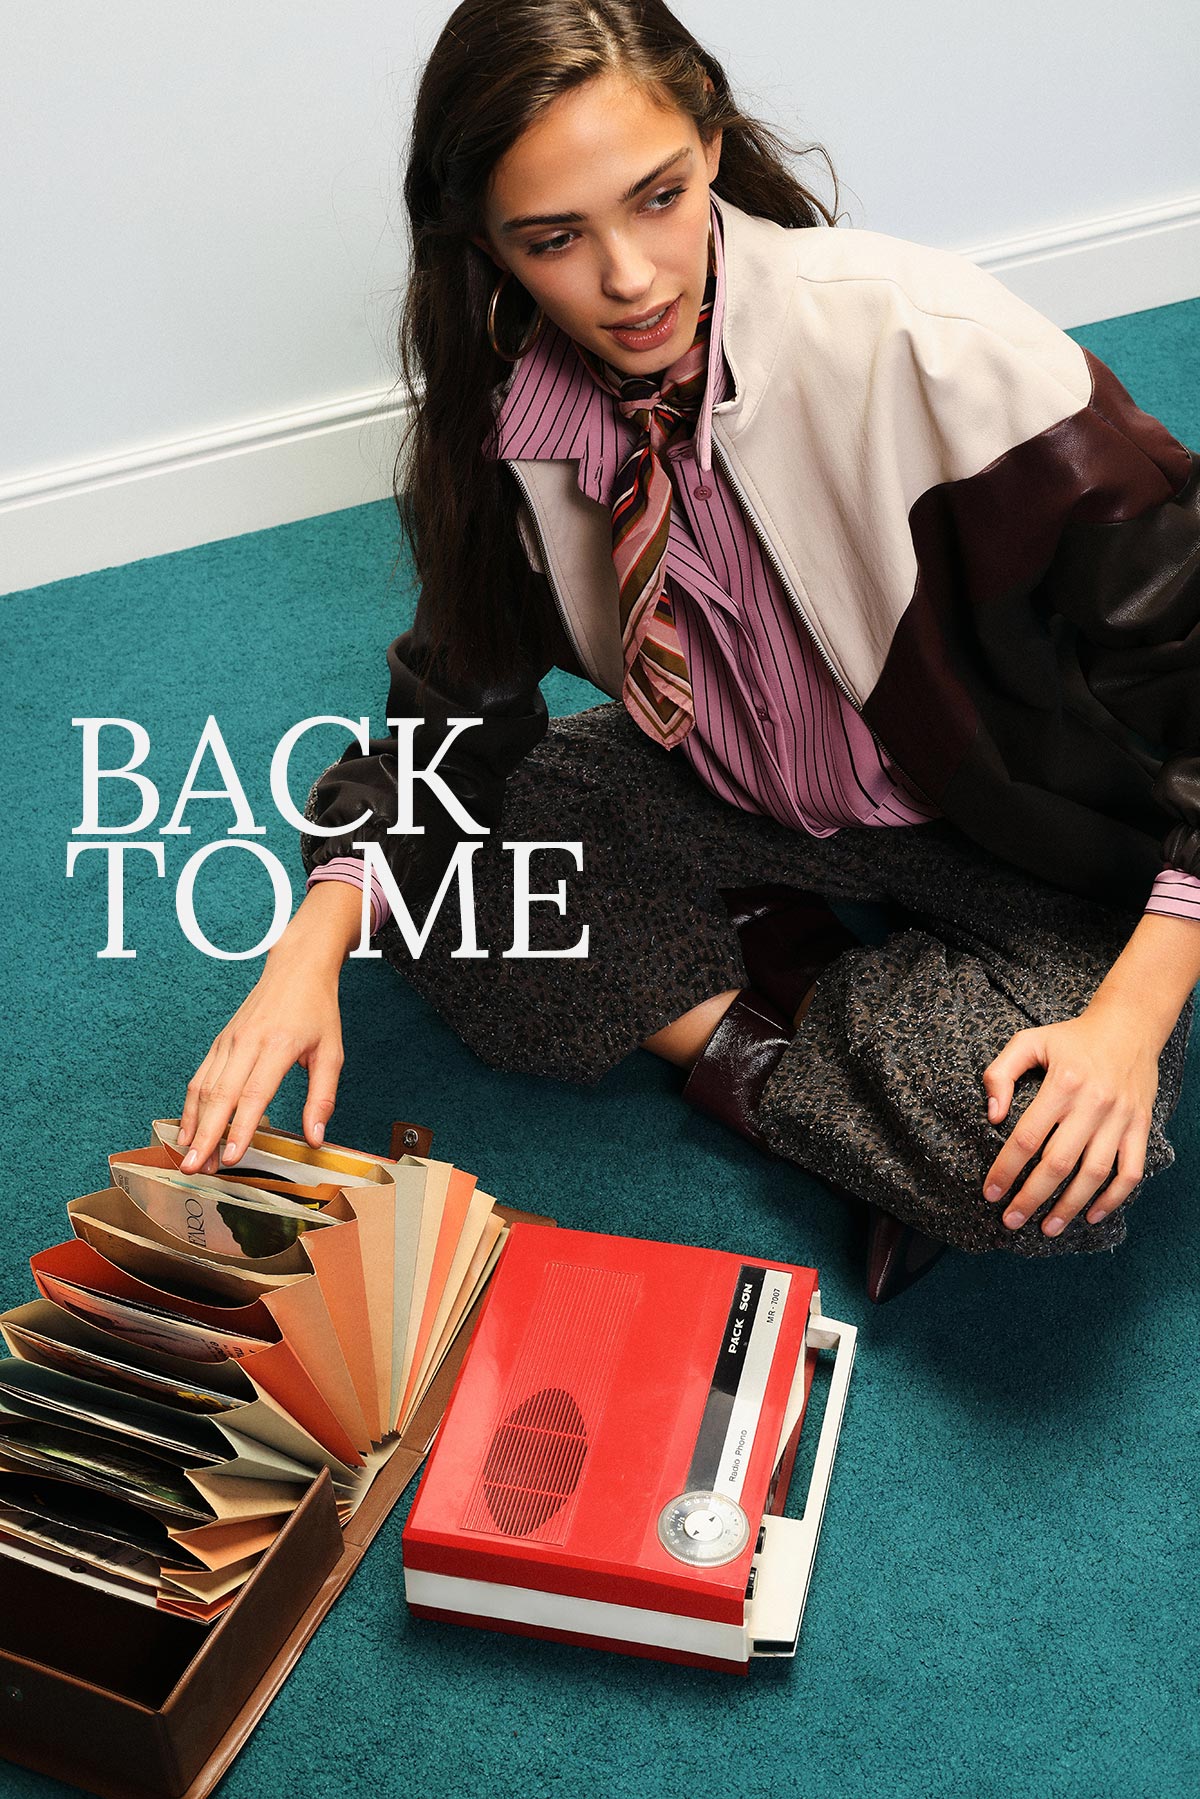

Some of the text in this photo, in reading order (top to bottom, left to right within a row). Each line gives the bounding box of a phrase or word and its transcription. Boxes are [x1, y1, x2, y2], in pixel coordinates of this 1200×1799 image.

[728, 1283, 753, 1354] PACK SON
[729, 1429, 748, 1483] Radio Phono
